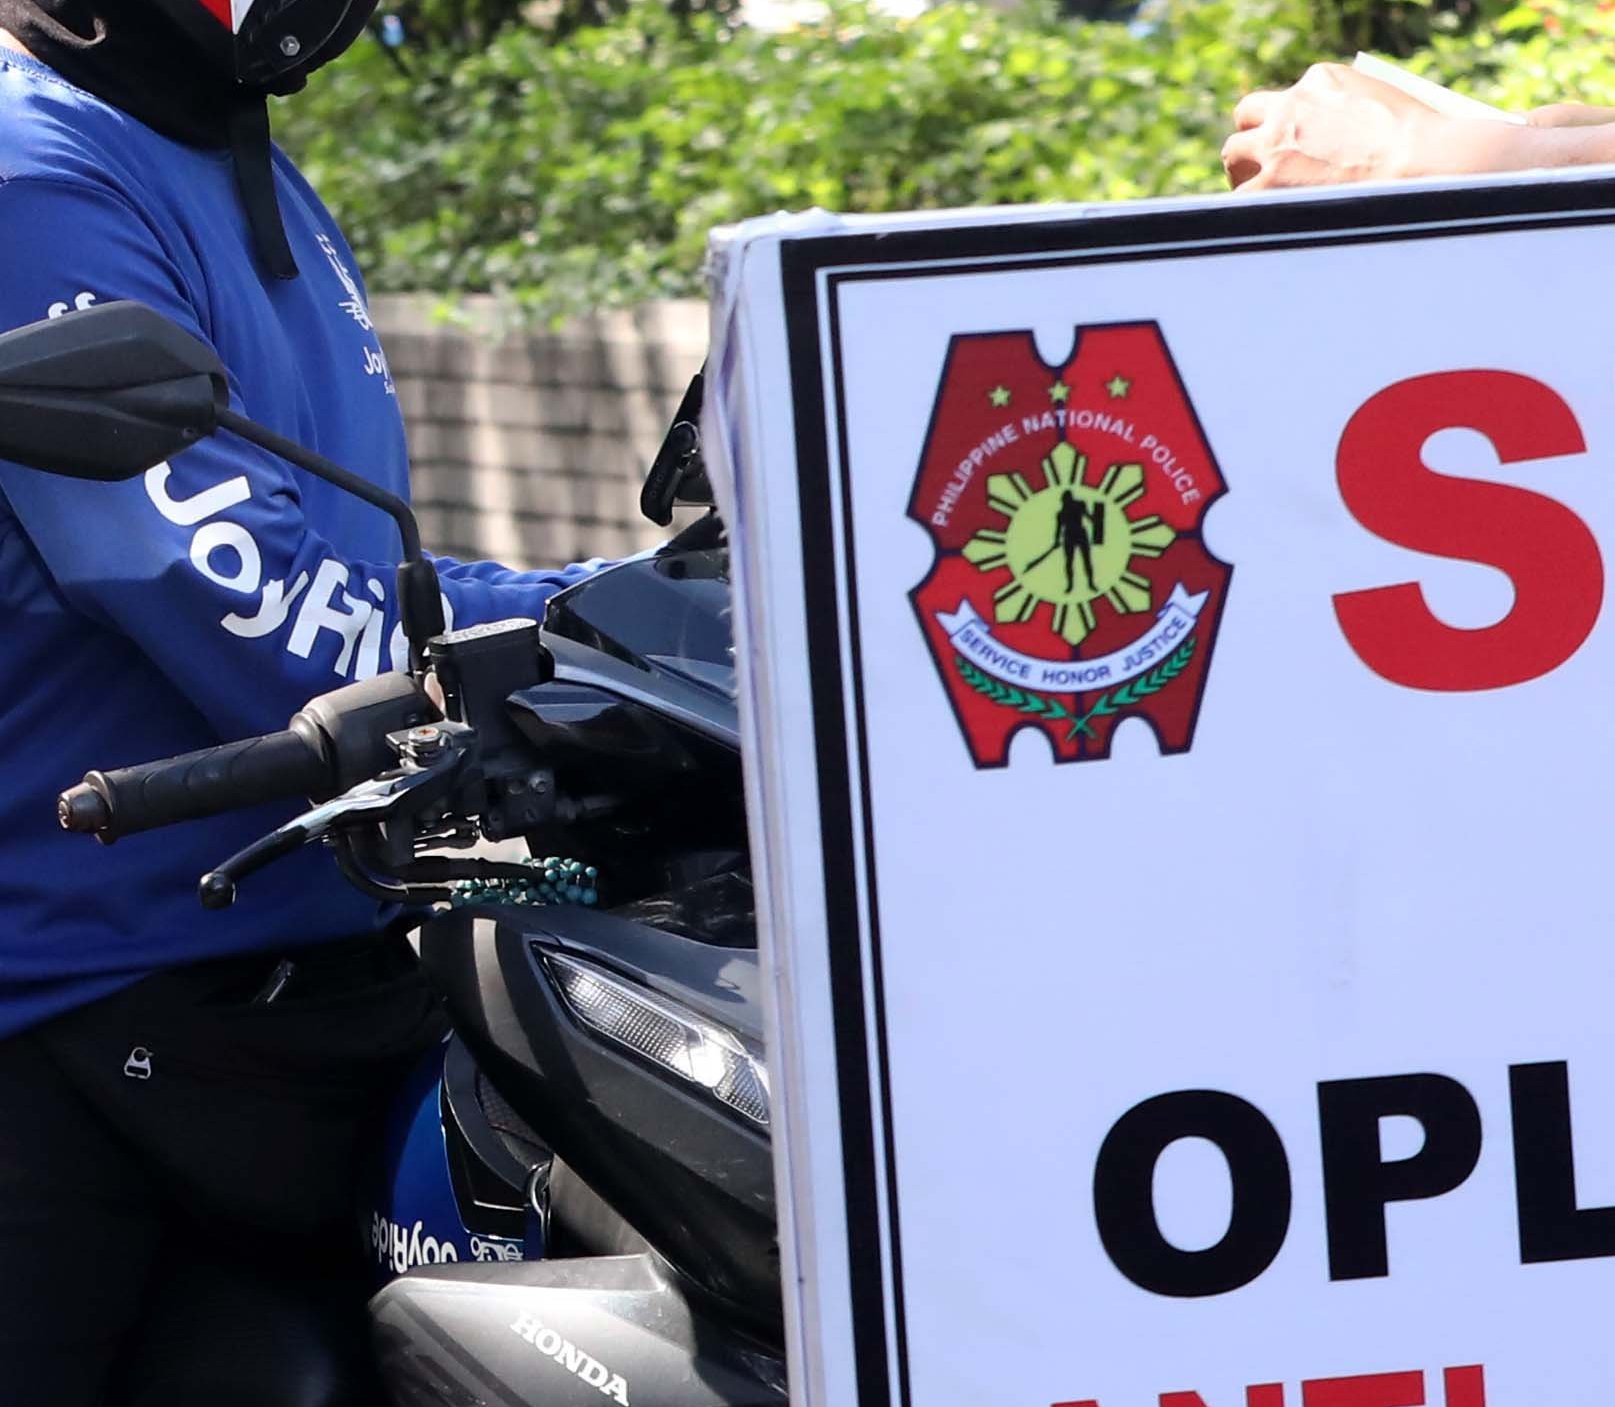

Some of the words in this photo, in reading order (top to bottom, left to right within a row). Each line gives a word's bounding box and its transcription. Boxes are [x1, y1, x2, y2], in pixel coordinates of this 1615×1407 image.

[932, 422, 1019, 528] PHILIPPINE
[1022, 409, 1136, 444] NATIONAL
[1141, 436, 1202, 506] POLICE
[960, 628, 1031, 680] SERVICE
[1042, 663, 1112, 686] HONOR
[1122, 616, 1187, 673] JUSTICE
[509, 1311, 630, 1407] HONDA
